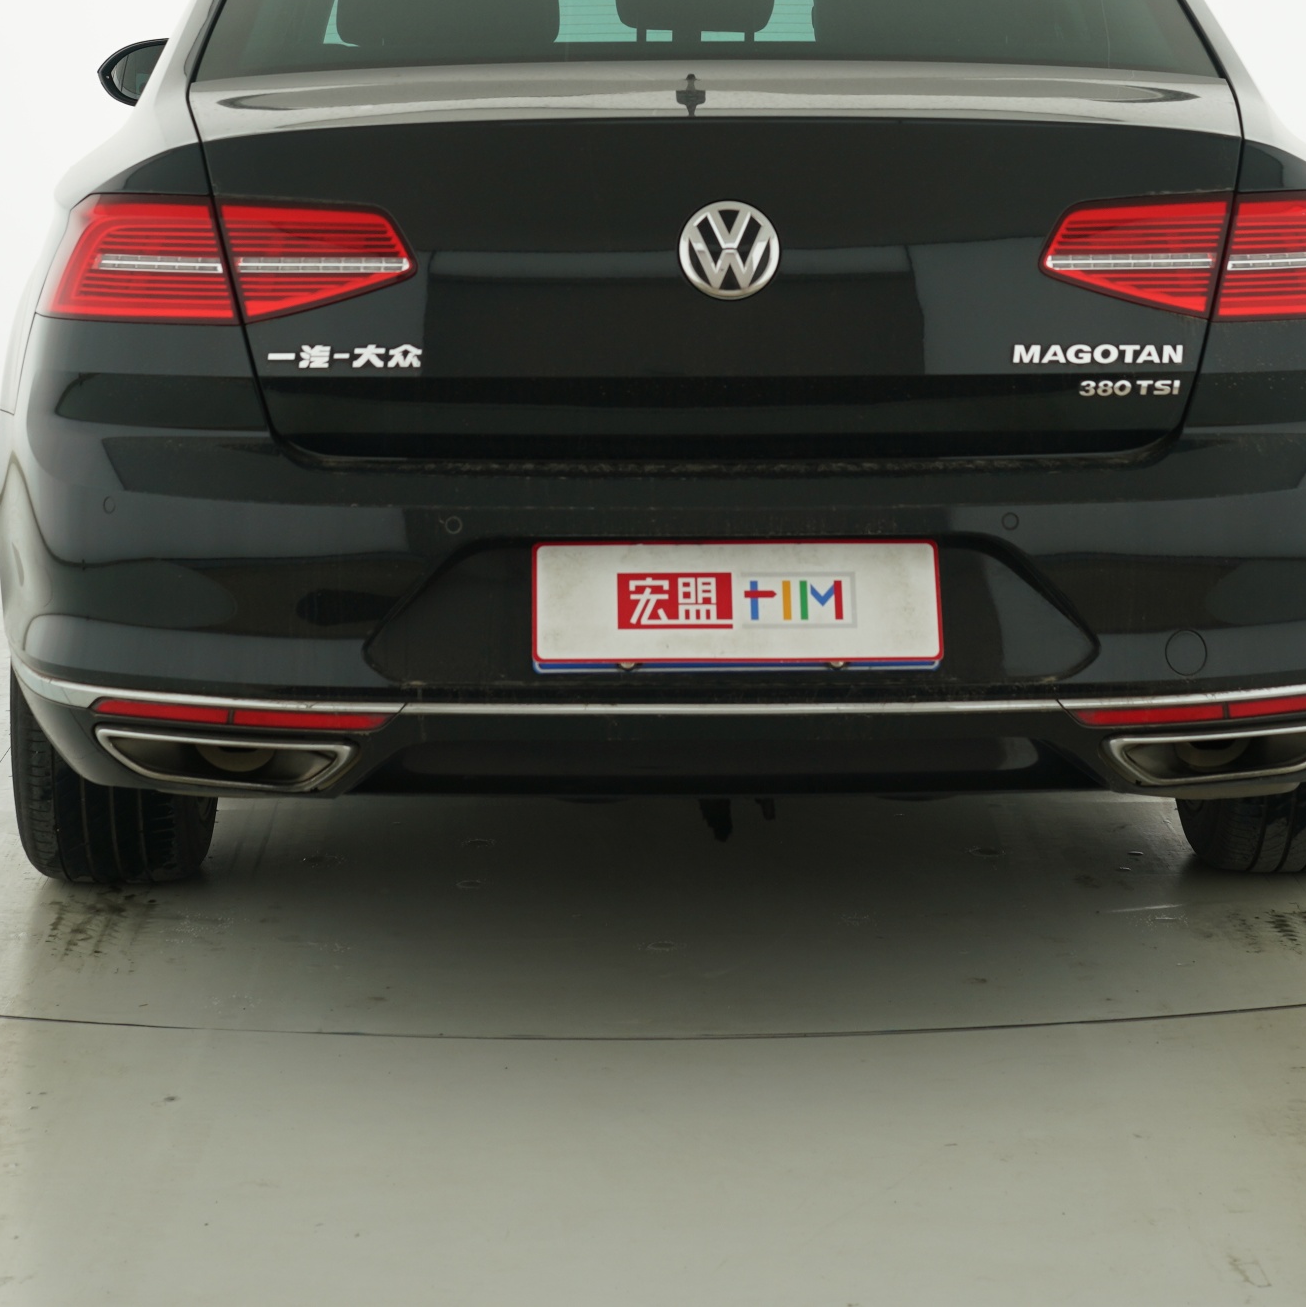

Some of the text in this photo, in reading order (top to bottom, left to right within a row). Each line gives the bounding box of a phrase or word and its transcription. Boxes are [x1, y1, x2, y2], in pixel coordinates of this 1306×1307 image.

[1012, 344, 1184, 364] MAGOTAN
[1079, 380, 1181, 396] 380 TSI
[629, 576, 718, 626] 宏盟
